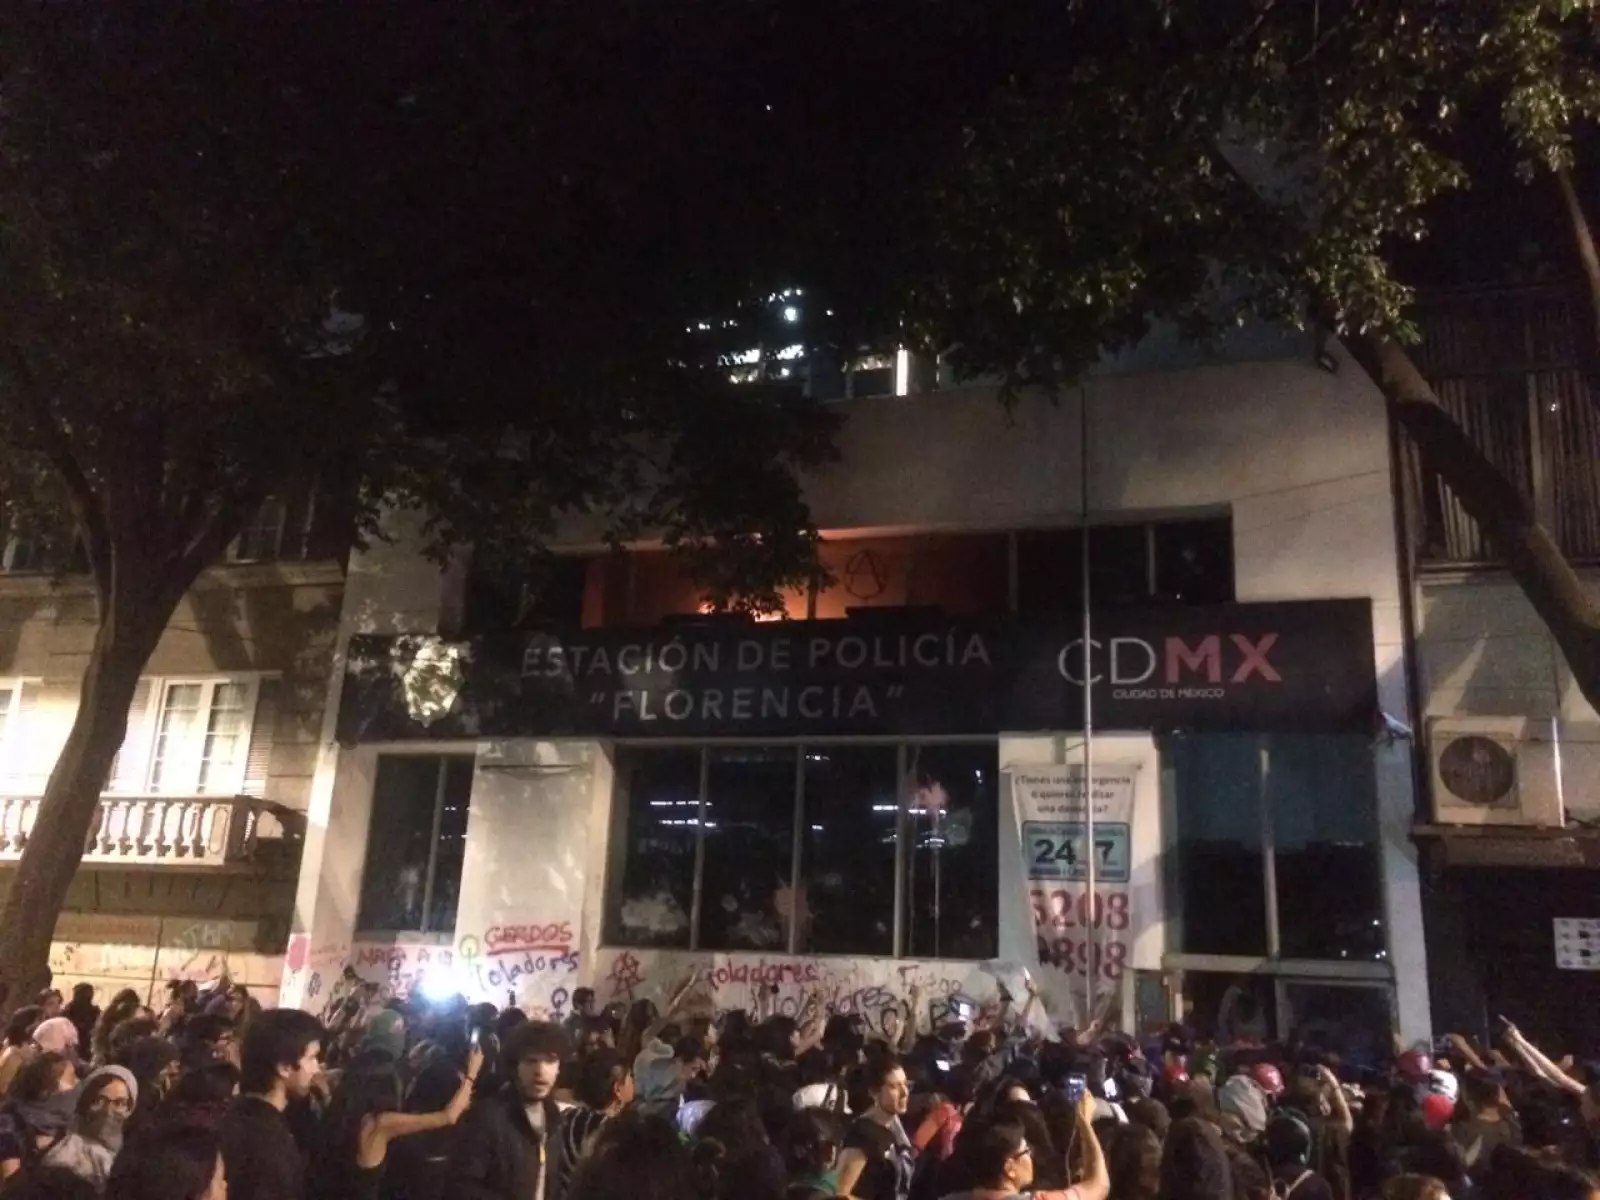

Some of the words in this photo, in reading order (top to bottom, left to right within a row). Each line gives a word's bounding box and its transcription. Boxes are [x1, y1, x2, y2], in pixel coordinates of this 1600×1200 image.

[520, 635, 719, 678] ESTACIÓN
[737, 639, 791, 672] DE
[808, 632, 991, 669] POLICÍA
[1057, 632, 1283, 687] CDMX
[1112, 687, 1157, 699] CIUDAD
[1160, 687, 1176, 698] DE
